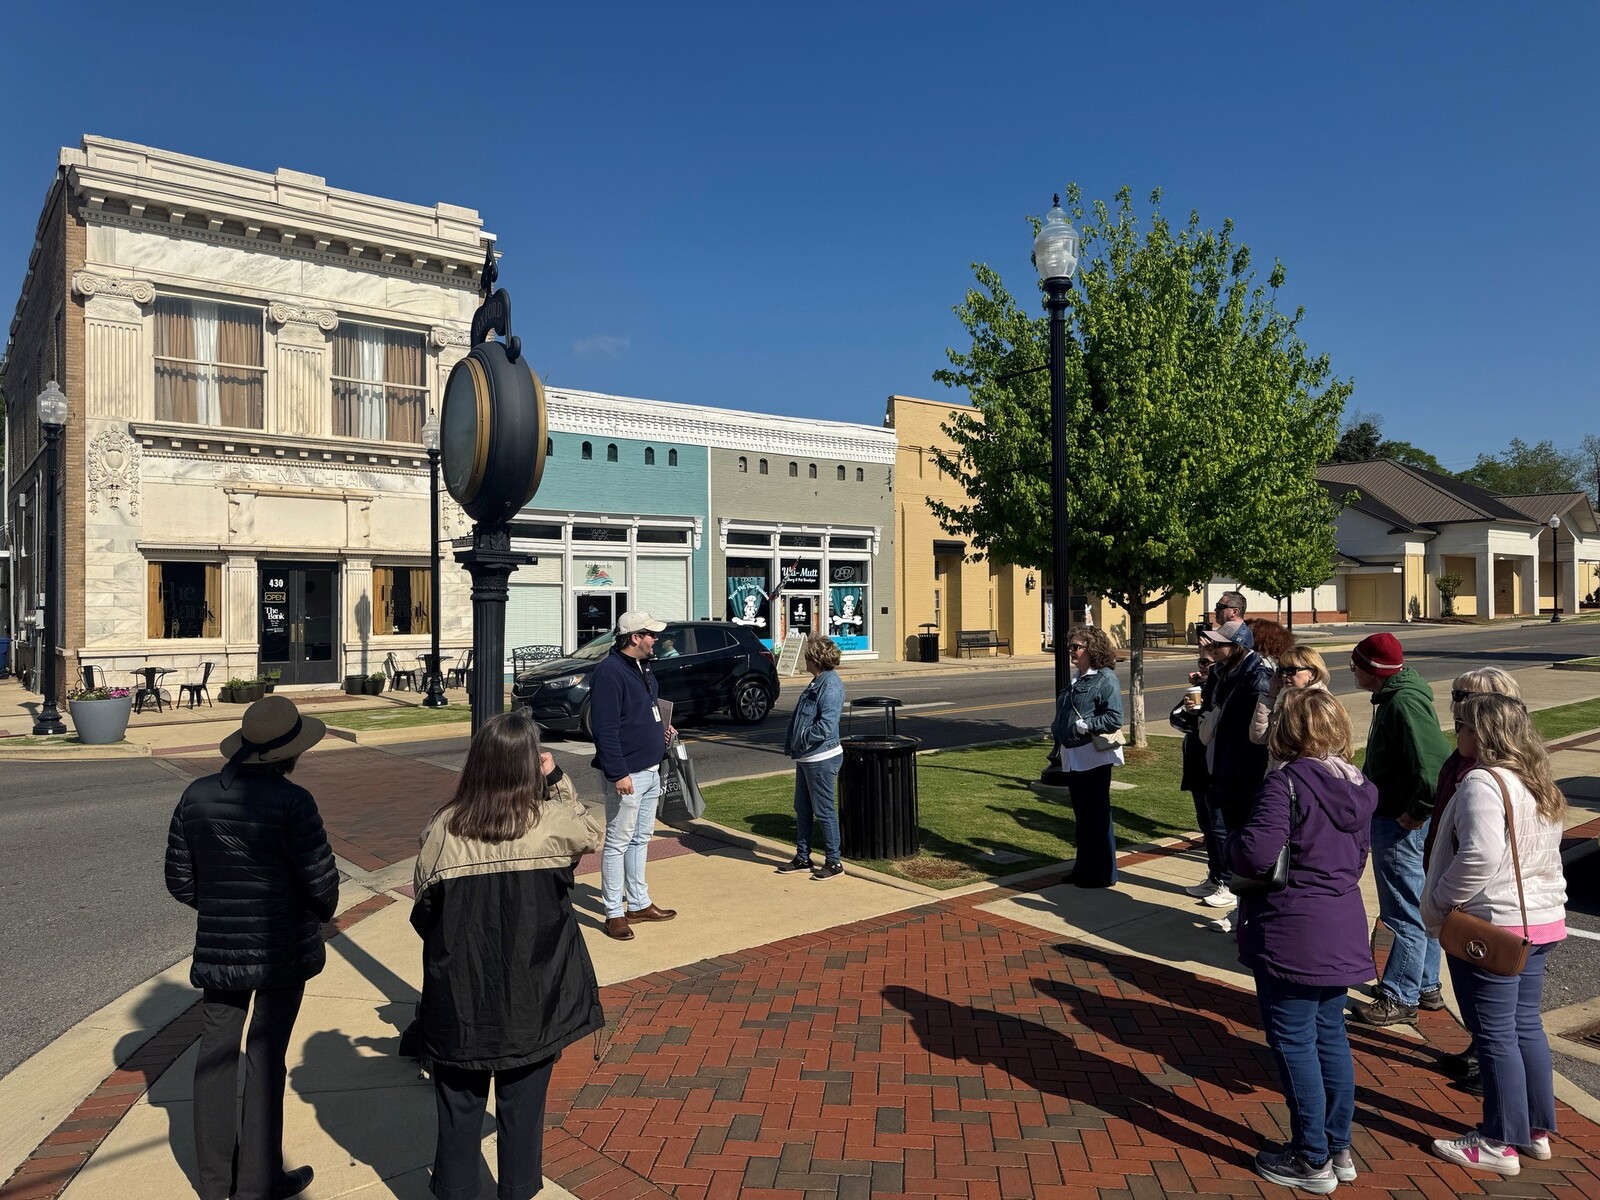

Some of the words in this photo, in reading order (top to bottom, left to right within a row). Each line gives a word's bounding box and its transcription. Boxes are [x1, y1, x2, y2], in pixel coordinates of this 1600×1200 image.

[475, 301, 503, 337] OXFORD
[269, 579, 284, 588] 430
[268, 612, 285, 620] Bank
